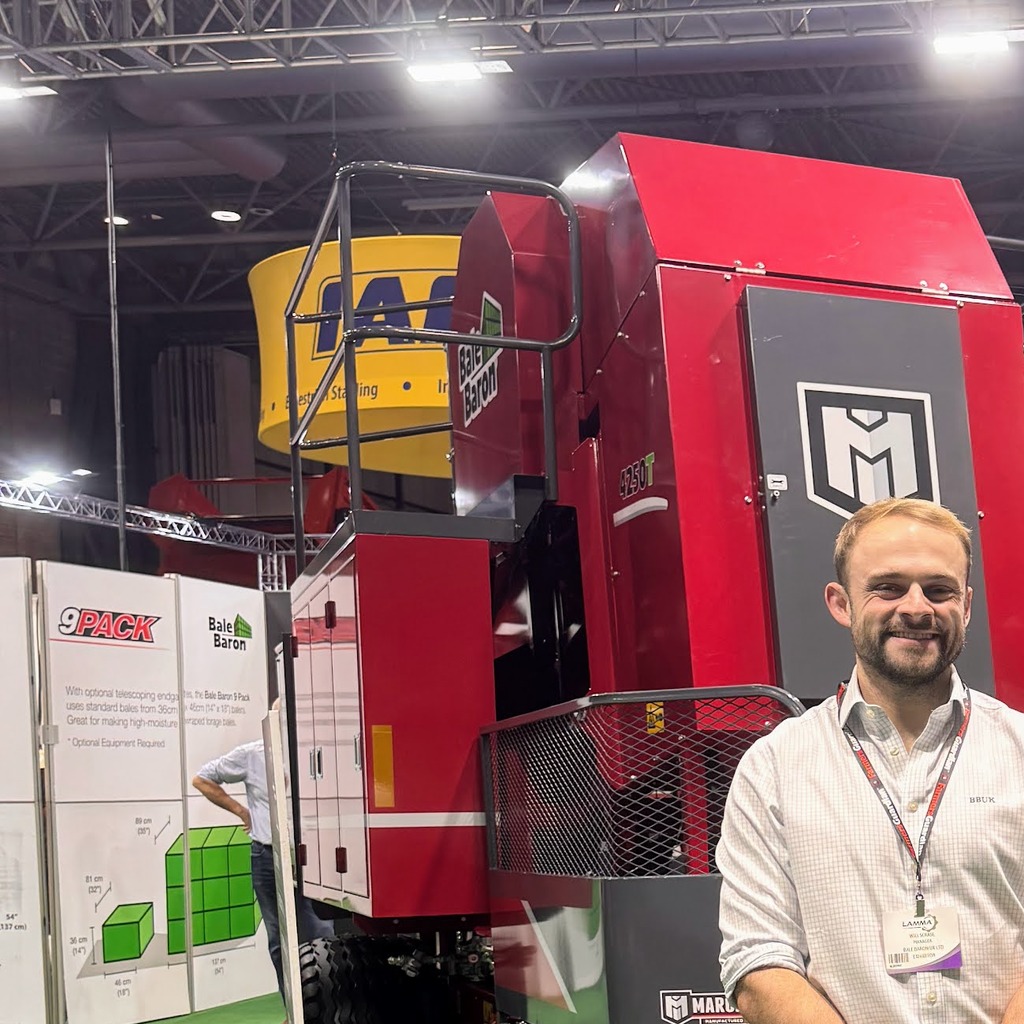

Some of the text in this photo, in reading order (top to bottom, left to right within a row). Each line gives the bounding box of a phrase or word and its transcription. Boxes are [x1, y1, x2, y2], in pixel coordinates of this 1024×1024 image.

[463, 362, 498, 424] Baron
[58, 607, 161, 643] 9PACK
[208, 617, 233, 634] Bale
[213, 634, 247, 651] Baron
[65, 686, 83, 696] With
[84, 688, 114, 698] optional
[115, 689, 156, 702] telescoping
[66, 702, 84, 711] uses
[86, 703, 118, 712] standard
[119, 704, 139, 713] bales
[140, 704, 157, 713] from
[67, 715, 88, 725] Great
[90, 717, 100, 725] for
[102, 717, 128, 728] making
[129, 718, 178, 729] high-moisture
[72, 737, 165, 748] Optional Equipment Required
[969, 796, 996, 804] BBUK
[902, 919, 933, 927] LAMMA
